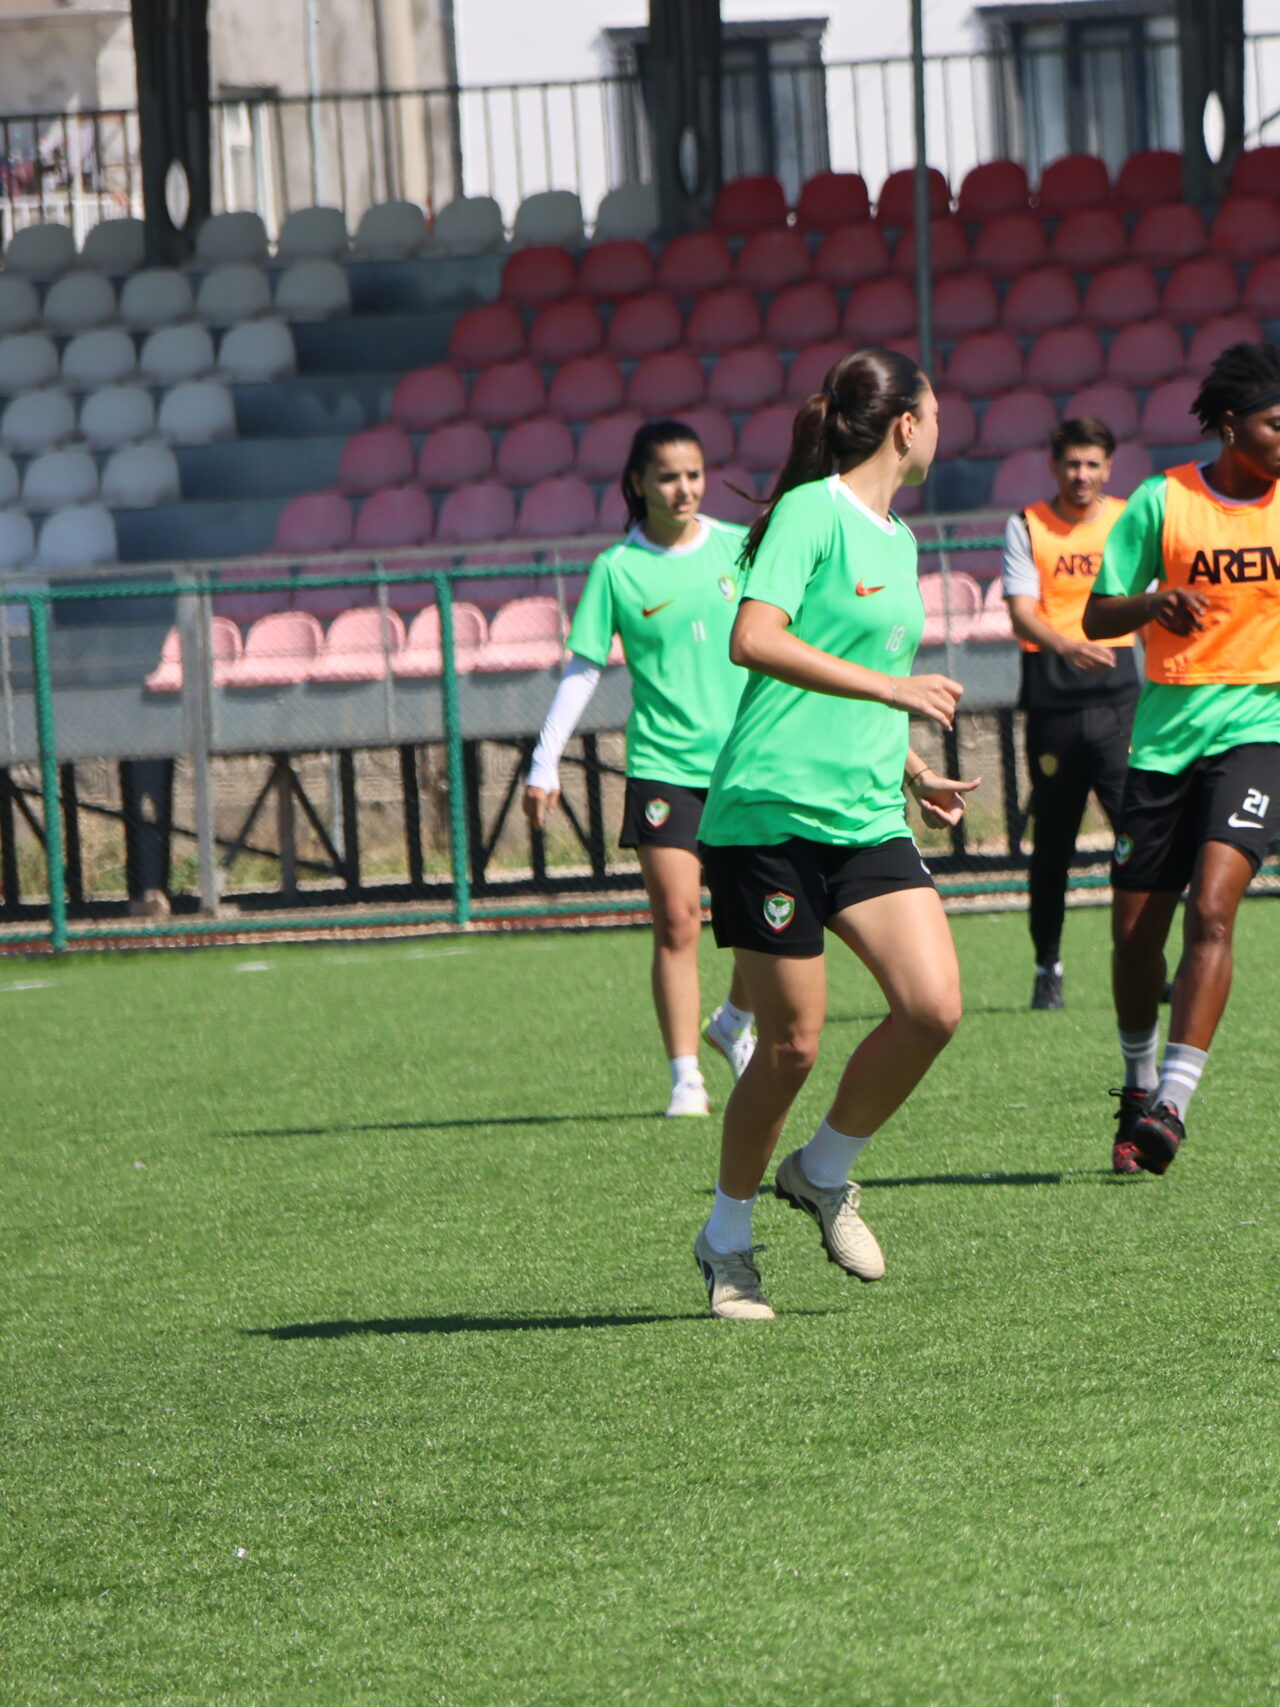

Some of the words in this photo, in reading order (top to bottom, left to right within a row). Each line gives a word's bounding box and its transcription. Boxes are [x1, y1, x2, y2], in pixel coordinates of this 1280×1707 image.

[1054, 552, 1102, 577] ARE
[884, 625, 906, 652] 18
[1242, 788, 1270, 818] 21
